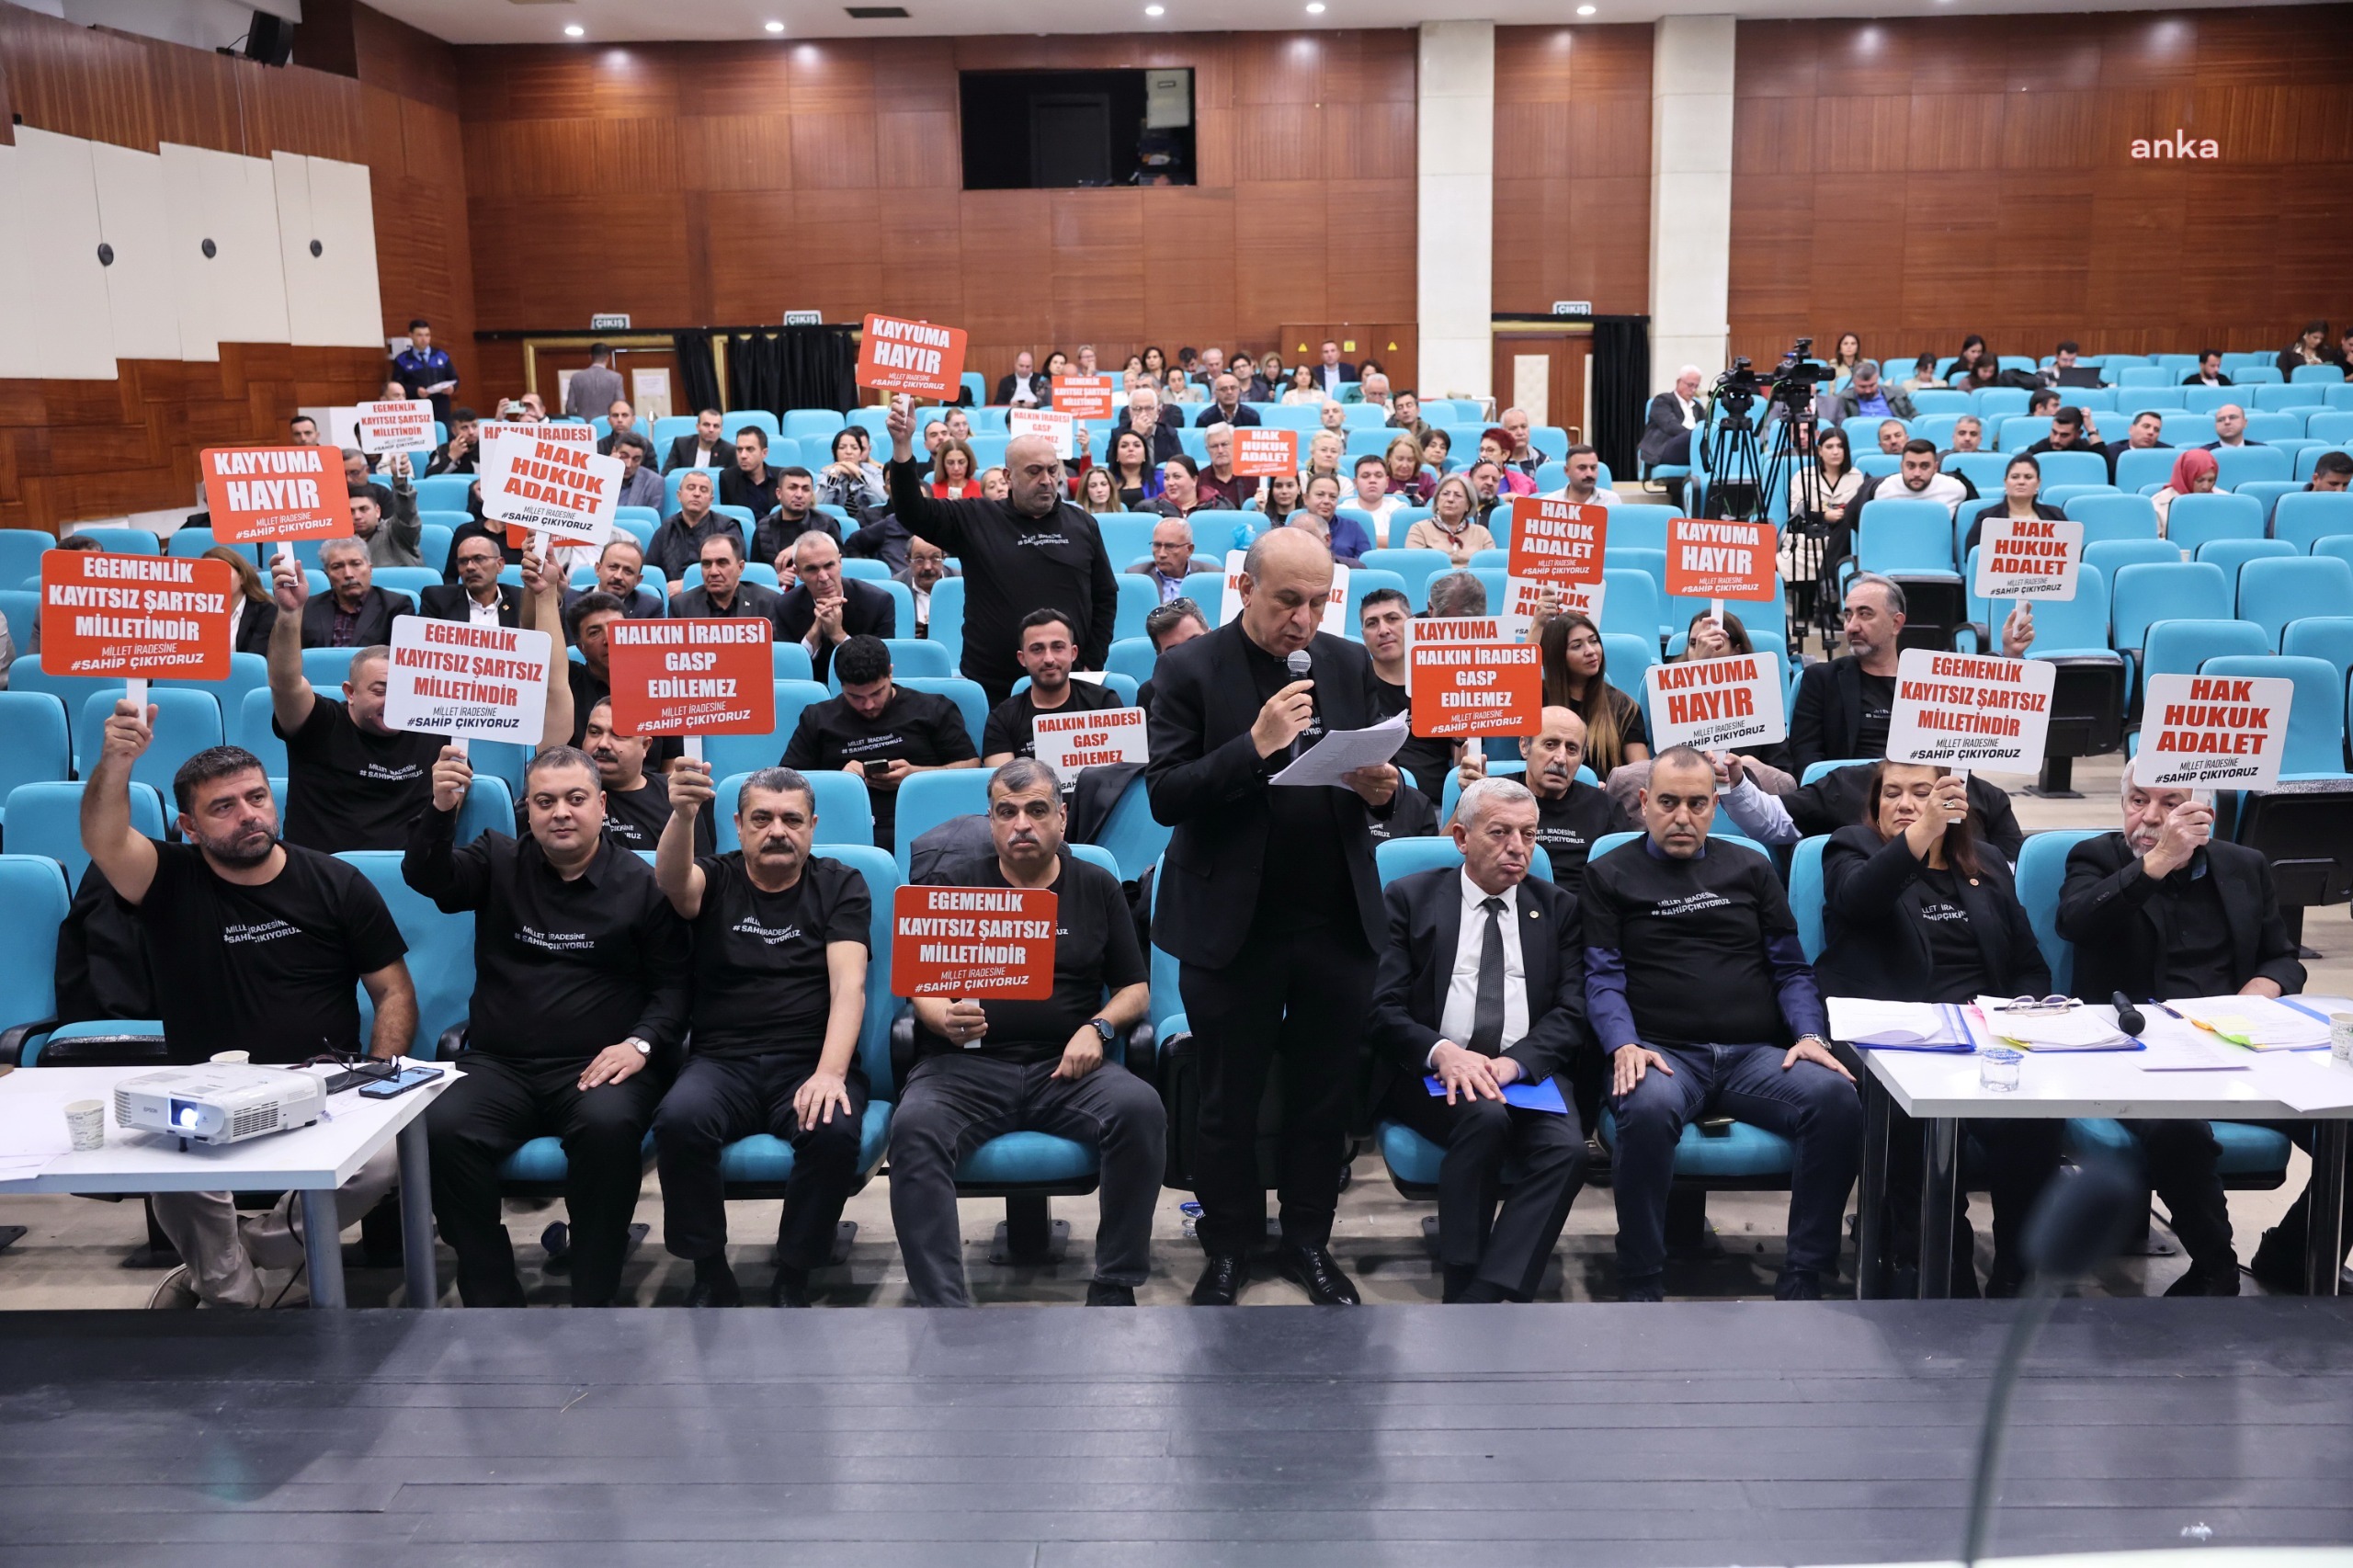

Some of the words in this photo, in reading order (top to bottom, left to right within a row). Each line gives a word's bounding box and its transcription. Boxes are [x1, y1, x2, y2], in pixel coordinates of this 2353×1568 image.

[872, 318, 949, 348] KAYYUMA
[873, 341, 941, 375] HAYIR
[903, 381, 945, 390] ÇIKIYORUZ
[373, 403, 416, 413] EGEMENLİK
[361, 415, 396, 426] KAYITSIZ
[398, 415, 430, 425] ŞARTSIZ
[1014, 412, 1040, 420] HALKIN
[1041, 413, 1070, 423] İRADESİ
[373, 426, 422, 437] MİLLETİNDİR
[538, 426, 592, 441] İRADESİ
[1033, 424, 1051, 432] GASP
[1252, 431, 1279, 440] HAK
[1242, 441, 1289, 451] HUKUK
[214, 450, 323, 475] KAYYUMA
[535, 442, 590, 470] HAK
[1240, 452, 1290, 462] ADALET
[511, 457, 605, 494] HUKUK
[226, 479, 320, 512] HAYIR
[504, 477, 602, 514] ADALET
[256, 517, 278, 527] MİLLET
[280, 512, 312, 524] İRADESİNE
[524, 506, 544, 516] MİLLET
[546, 507, 576, 519] İRADESİNE
[1541, 502, 1582, 520] HAK
[235, 526, 275, 540] #SAHİP
[278, 518, 333, 535] ÇIKIYORUZ
[502, 512, 539, 522] #SAHİP
[541, 517, 593, 530] ÇIKIYORUZ
[1525, 518, 1595, 540] HUKUK
[2012, 522, 2055, 538] HAK
[1677, 522, 1759, 545] KAYYUMA
[1521, 537, 1594, 559] ADALET
[1995, 540, 2068, 557] HUKUK
[1682, 545, 1752, 574] HAYIR
[1990, 558, 2067, 575] ADALET
[84, 557, 193, 583] EGEMENLİK
[1552, 567, 1590, 575] ÇIKIYORUZ
[1682, 585, 1712, 593] #SAHİP
[1715, 584, 1759, 593] ÇIKIYORUZ
[1990, 586, 2019, 596] #SAHİP
[2021, 585, 2062, 595] ÇIKIYORUZ
[49, 585, 140, 609] KAYITSIZ
[144, 590, 225, 613] ŞARTSIZ
[75, 614, 199, 641] MİLLETİNDİR
[615, 626, 683, 644] HALKIN
[689, 621, 765, 643] İRADESİ
[1415, 621, 1498, 641] KAYYUMA
[425, 623, 517, 652] EGEMENLİK
[102, 644, 131, 656] MİLLET
[134, 642, 177, 654] İRADESİNE
[1416, 650, 1471, 665] HALKIN
[1475, 647, 1537, 665] İRADESİ
[71, 656, 125, 671] #SAHİP
[130, 653, 204, 670] ÇIKIYORUZ
[395, 648, 469, 673] KAYITSIZ
[472, 657, 542, 682] ŞARTSIZ
[665, 653, 717, 671] GASP
[1932, 657, 2023, 682] EGEMENLİK
[1456, 671, 1497, 686] GASP
[1657, 659, 1758, 690] KAYYUMA
[414, 676, 517, 706] MİLLETİNDİR
[648, 676, 736, 698] EDİLEMEZ
[1901, 681, 1974, 705] KAYITSIZ
[1977, 688, 2046, 711] ŞARTSIZ
[2190, 679, 2253, 701] HAK
[1441, 690, 1512, 707] EDİLEMEZ
[1667, 687, 1754, 724] HAYIR
[433, 706, 459, 717] MİLLET
[460, 706, 497, 716] İRADESİNE
[662, 706, 687, 717] MİLLET
[689, 701, 726, 715] İRADESİNE
[1451, 713, 1472, 722] MİLLET
[1473, 710, 1503, 720] İRADESİNE
[2164, 705, 2270, 729] HUKUK
[407, 716, 452, 727] #SAHİP
[456, 719, 519, 729] ÇIKIYORUZ
[637, 717, 682, 732] #SAHİP
[687, 710, 751, 728] ÇIKIYORUZ
[1038, 717, 1085, 733] HALKIN
[1088, 710, 1142, 728] İRADESİ
[1431, 722, 1467, 733] #SAHİP
[1471, 716, 1523, 730] ÇIKIYORUZ
[1694, 727, 1714, 738] MİLLET
[1715, 720, 1745, 733] İRADESİNE
[1918, 709, 2020, 736] MİLLETİNDİR
[1074, 733, 1108, 748] GASP
[1714, 724, 1765, 744] ÇIKIYORUZ
[1936, 737, 1961, 748] MİLLET
[1962, 737, 1999, 747] İRADESİNE
[2156, 732, 2268, 755] ADALET
[1062, 750, 1123, 767] EDİLEMEZ
[1910, 748, 1954, 759] #SAHİP
[1958, 749, 2020, 761] ÇIKIYORUZ
[2179, 760, 2204, 771] MİLLET
[2205, 757, 2239, 769] İRADESİNE
[2155, 772, 2196, 783] #SAHİP
[2200, 767, 2259, 782] ÇIKIYORUZ
[928, 891, 1023, 912] EGEMENLİK
[549, 932, 585, 940] İRADESİNE
[899, 917, 975, 937] KAYITSIZ
[979, 920, 1050, 941] ŞARTSIZ
[920, 942, 1026, 964] MİLLETİNDİR
[941, 970, 967, 981] MİLLET
[969, 966, 1006, 978] İRADESİNE
[915, 981, 961, 993] #SAHİP
[965, 975, 1029, 991] ÇIKIYORUZ
